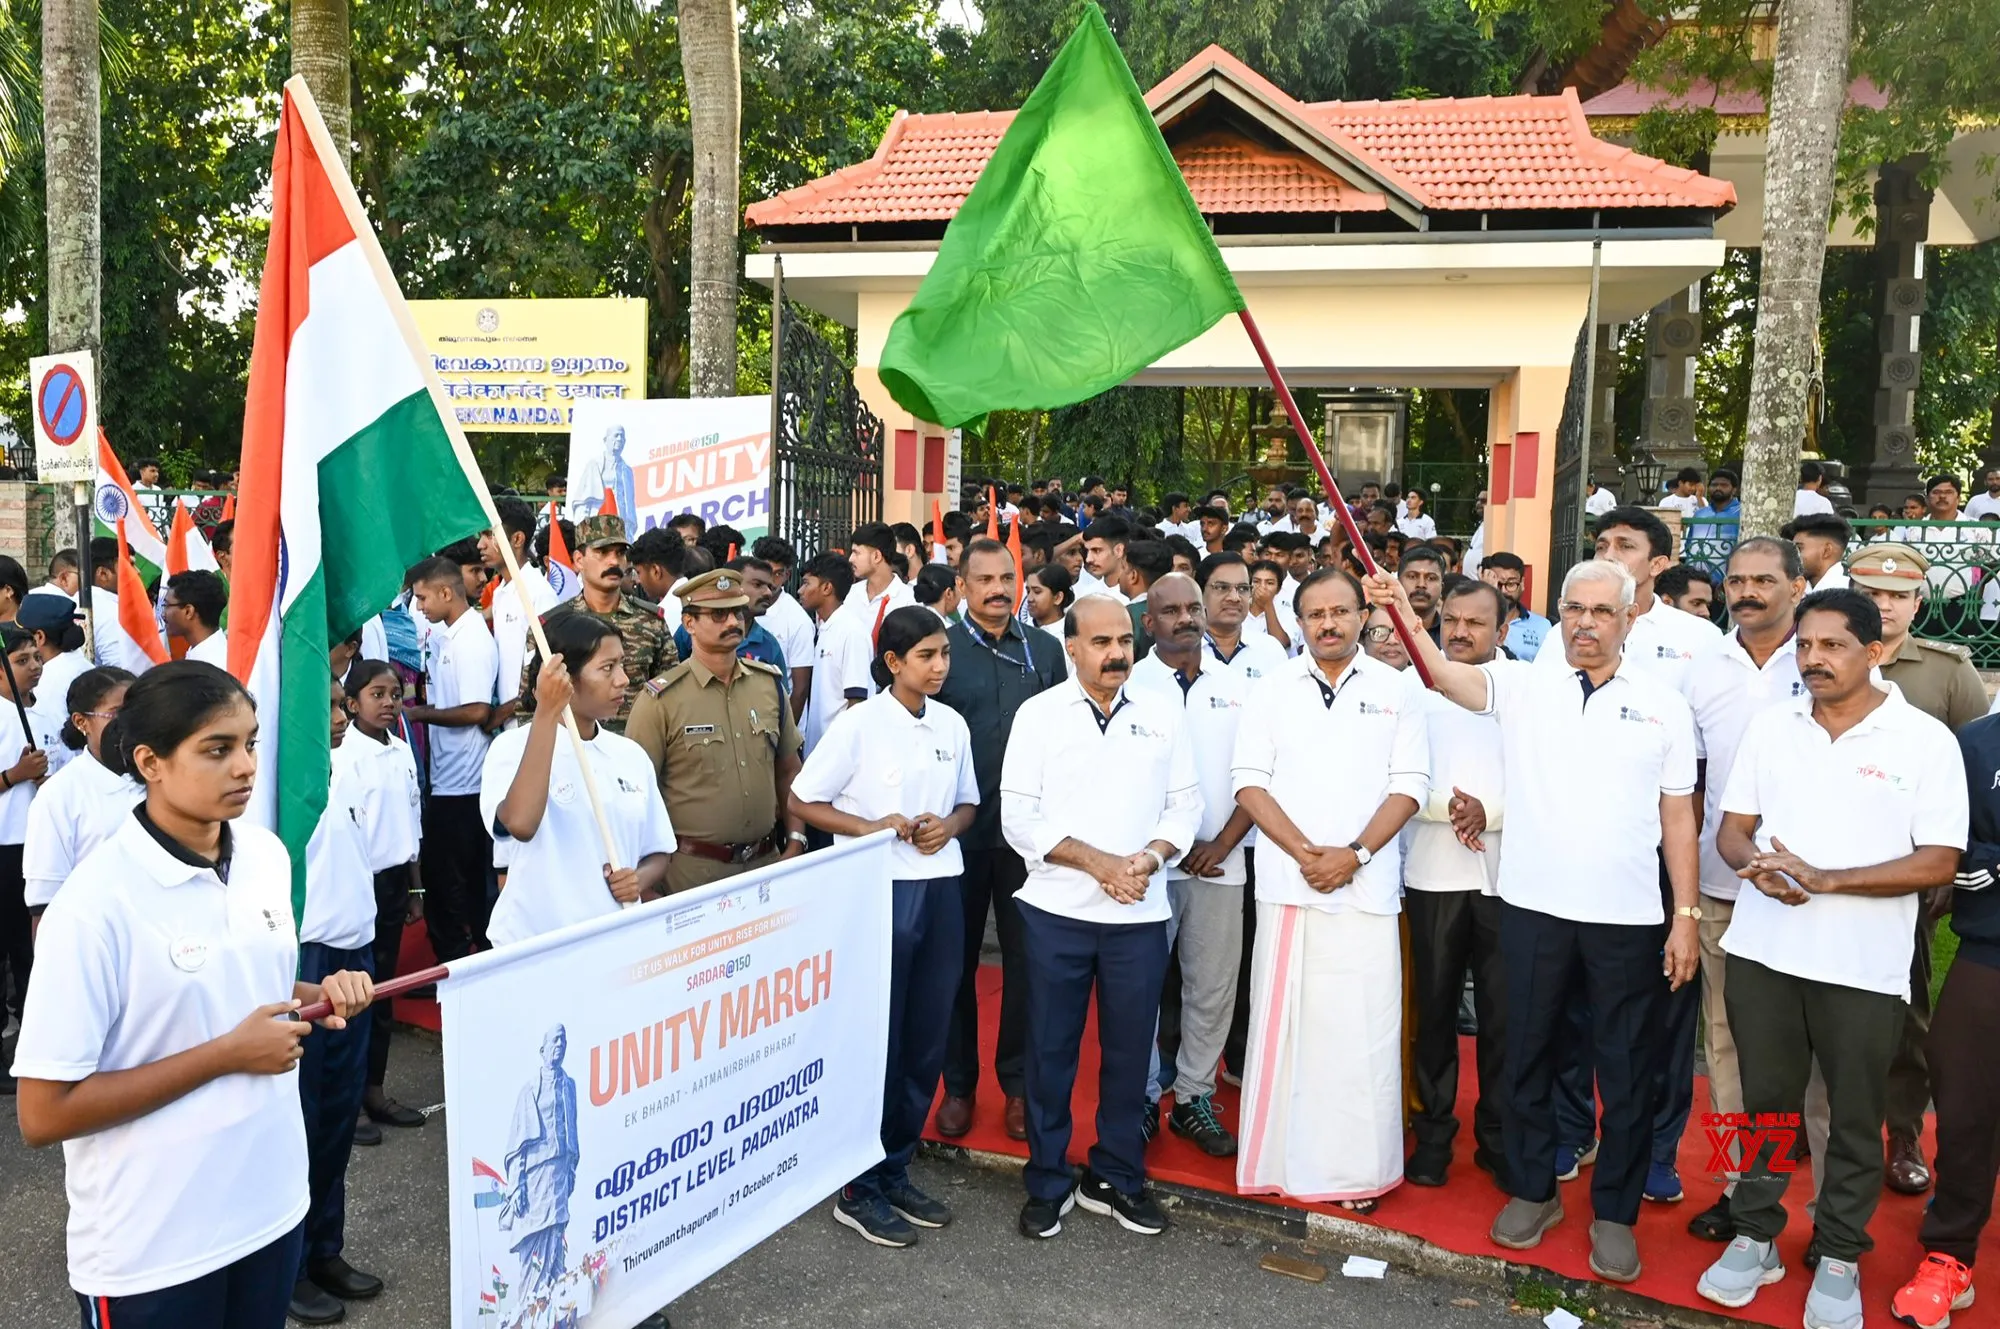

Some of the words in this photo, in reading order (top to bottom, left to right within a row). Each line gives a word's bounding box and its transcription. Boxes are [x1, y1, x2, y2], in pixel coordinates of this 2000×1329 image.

[431, 354, 545, 372] ിവേകാനന്ദ
[647, 437, 770, 499] UNITY
[648, 432, 720, 461] SARDAR@150
[631, 963, 649, 979] LET
[651, 960, 663, 974] US
[663, 949, 689, 968] WALK
[690, 943, 706, 959] FOR
[708, 934, 735, 953] UNITY,
[735, 927, 754, 943] RISE
[754, 921, 769, 936] FOR
[686, 953, 751, 992] SARDAR@150
[589, 999, 711, 1107] UNITY
[718, 949, 832, 1050] MARCH
[624, 1111, 638, 1128] EK
[642, 1090, 681, 1120] BHARAT
[692, 1049, 762, 1095] AATMANIRBHAR
[764, 1033, 797, 1059] BHARAT
[595, 1119, 714, 1200] ഏകതാ
[723, 1057, 824, 1134] പദയാത്ര
[595, 1176, 682, 1244] DISTRICT
[686, 1146, 736, 1193] LEVEL
[741, 1095, 819, 1161] PADAYATRA
[622, 1206, 719, 1273] Thiruvananthapuram
[728, 1188, 741, 1208] 31
[742, 1171, 776, 1199] October
[777, 1153, 799, 1178] 2025
